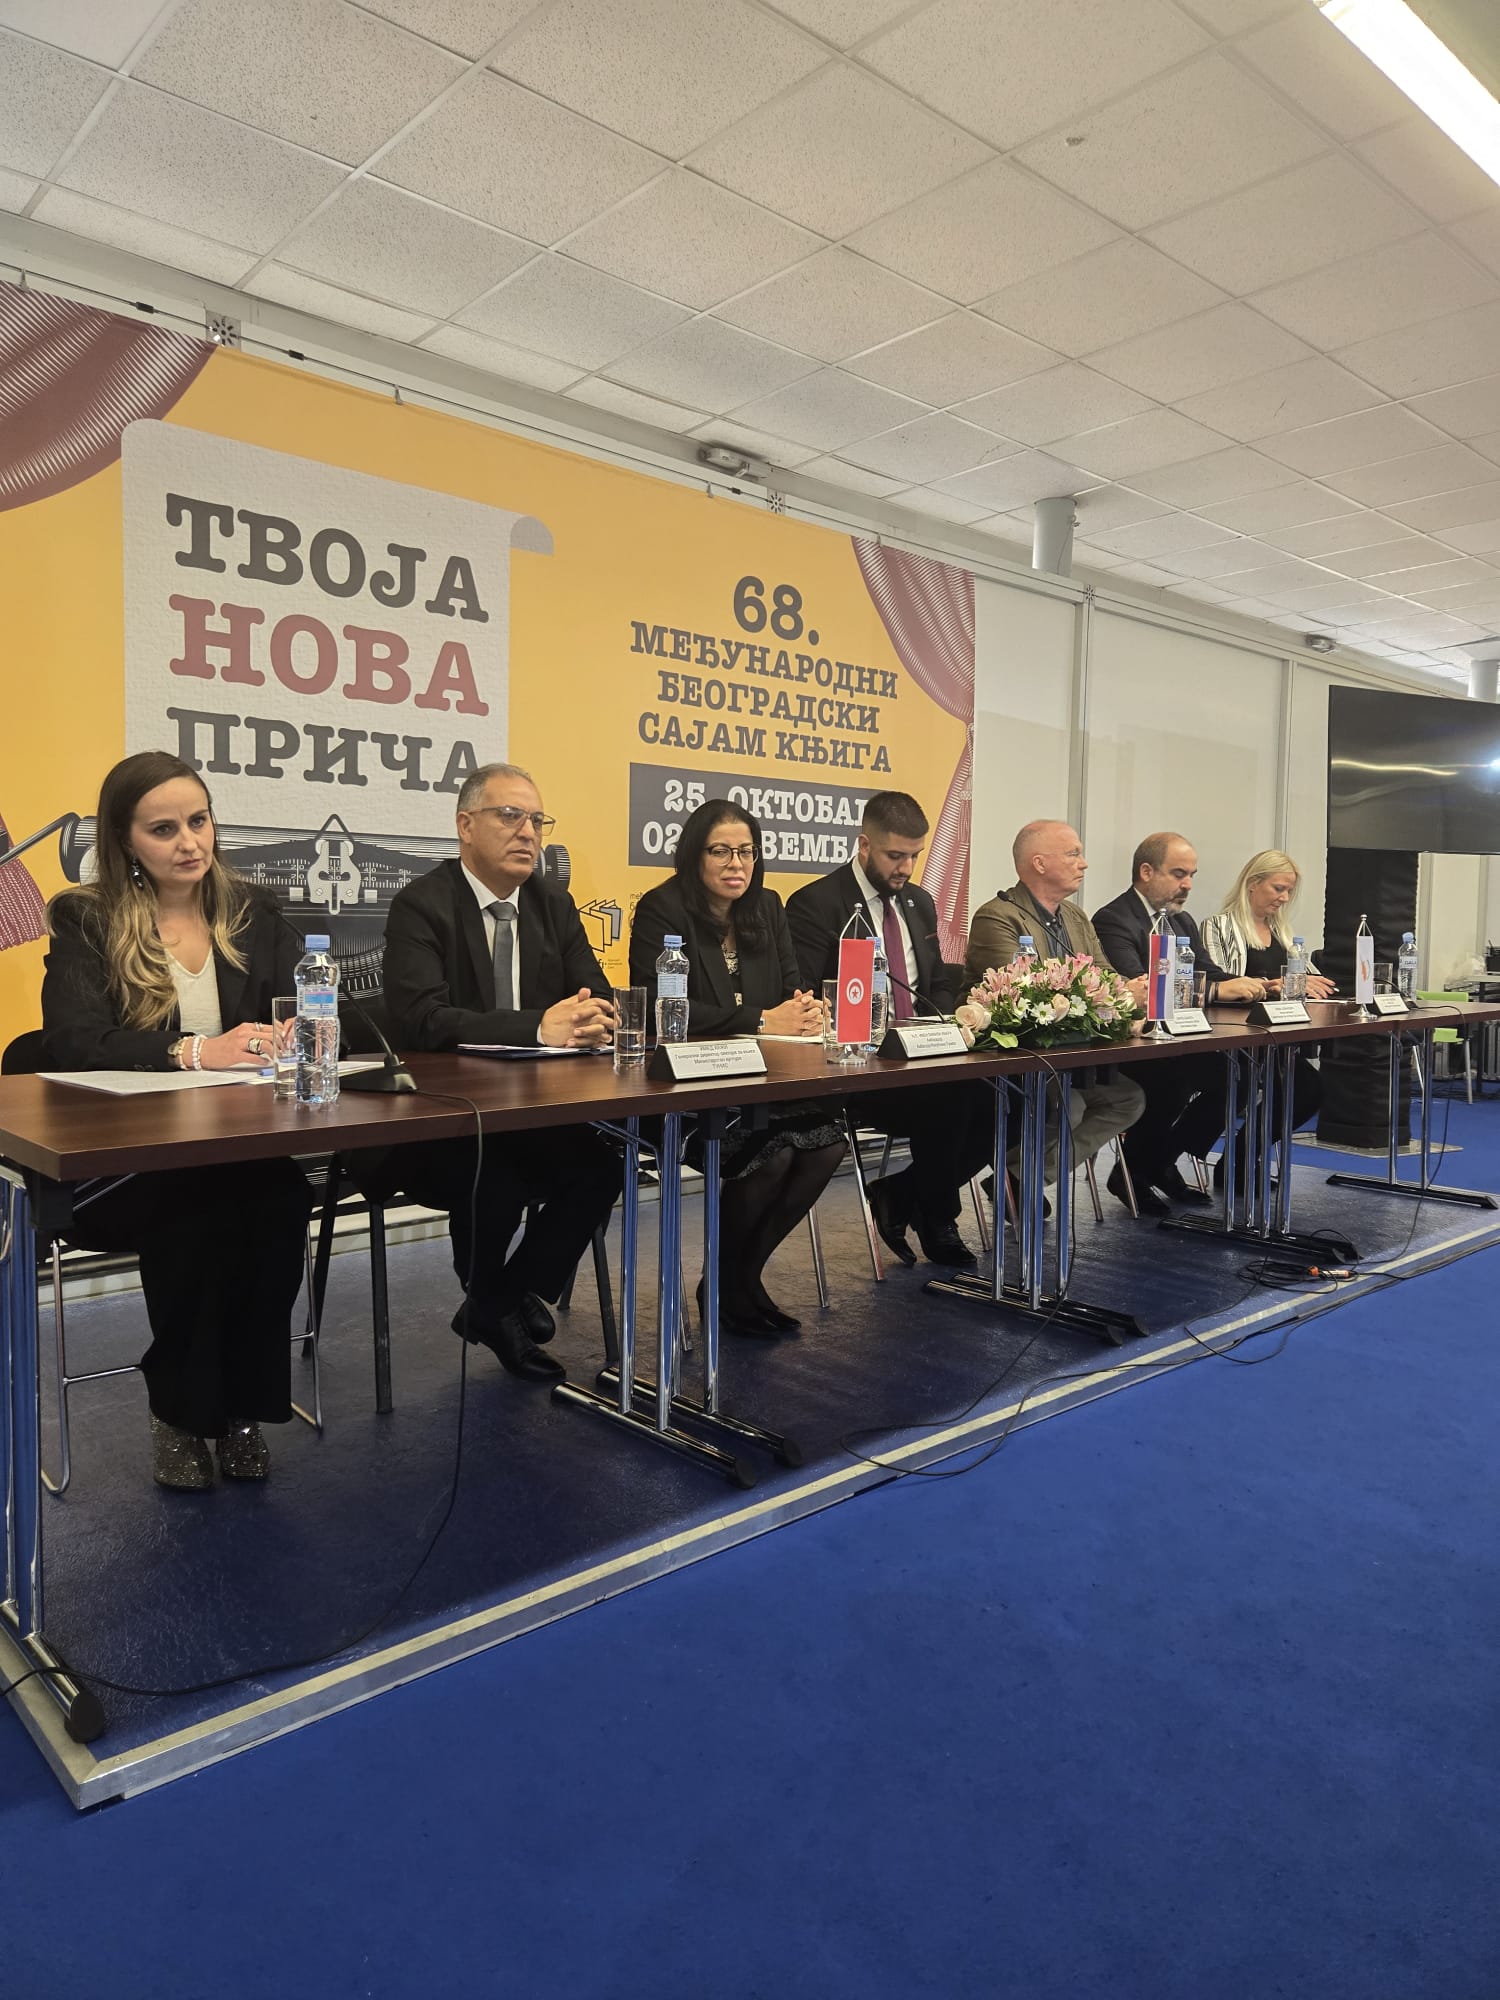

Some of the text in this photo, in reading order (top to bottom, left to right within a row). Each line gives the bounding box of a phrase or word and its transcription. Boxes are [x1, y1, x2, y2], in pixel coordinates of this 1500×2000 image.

[166, 492, 489, 623] ТВОЈА
[733, 575, 820, 645] 68.
[168, 593, 489, 716] НОВА
[630, 621, 898, 699] МЕЂУНАРОДНИ
[657, 670, 880, 733] БЕОГРАДСКИ
[166, 706, 481, 794] ПРИЧА
[638, 712, 892, 773] САЈАМ КЊИГА
